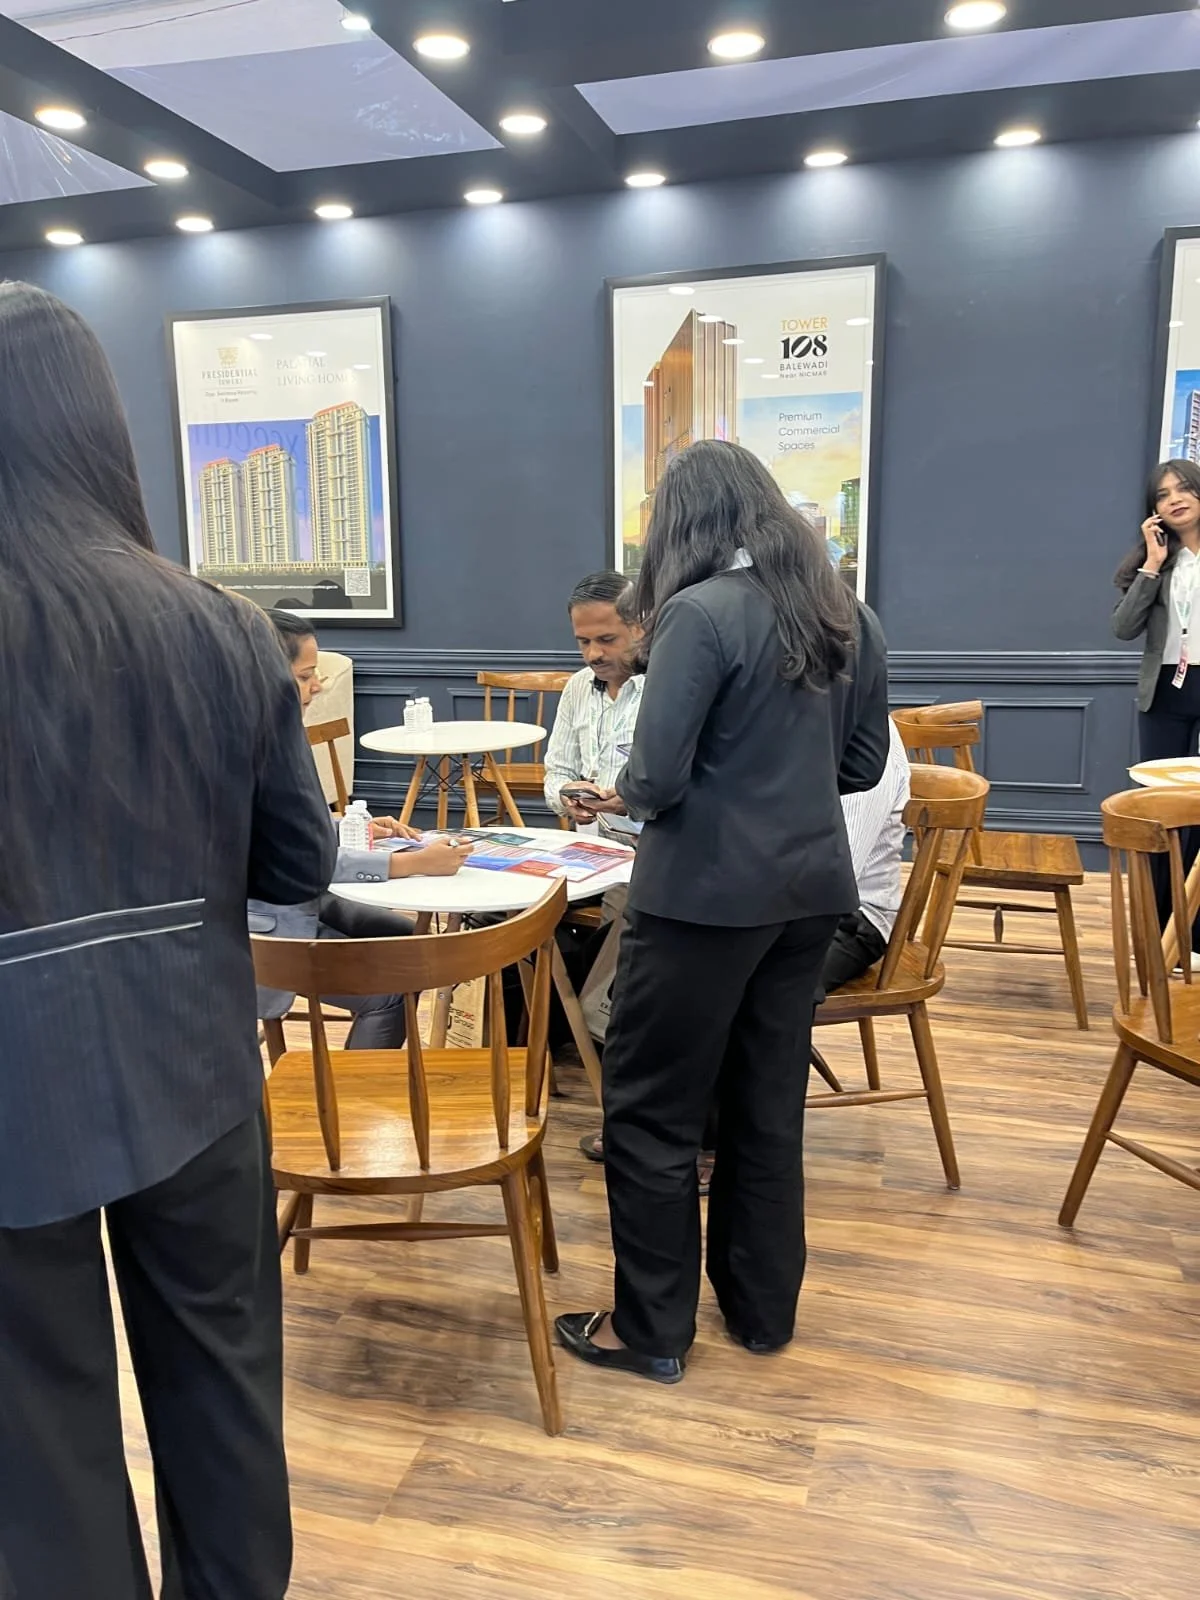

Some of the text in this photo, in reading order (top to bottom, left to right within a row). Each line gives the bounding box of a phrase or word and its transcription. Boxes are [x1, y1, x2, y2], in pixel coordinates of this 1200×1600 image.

[781, 317, 828, 331] TOWER
[781, 334, 828, 359] 108
[276, 356, 326, 369] PALIAL
[779, 361, 828, 371] BALEWADI
[201, 368, 258, 379] PRESIDENTIAL
[277, 374, 315, 386] LIVING
[779, 411, 822, 421] Premium
[779, 425, 840, 437] Commercial
[779, 440, 816, 452] Spaces
